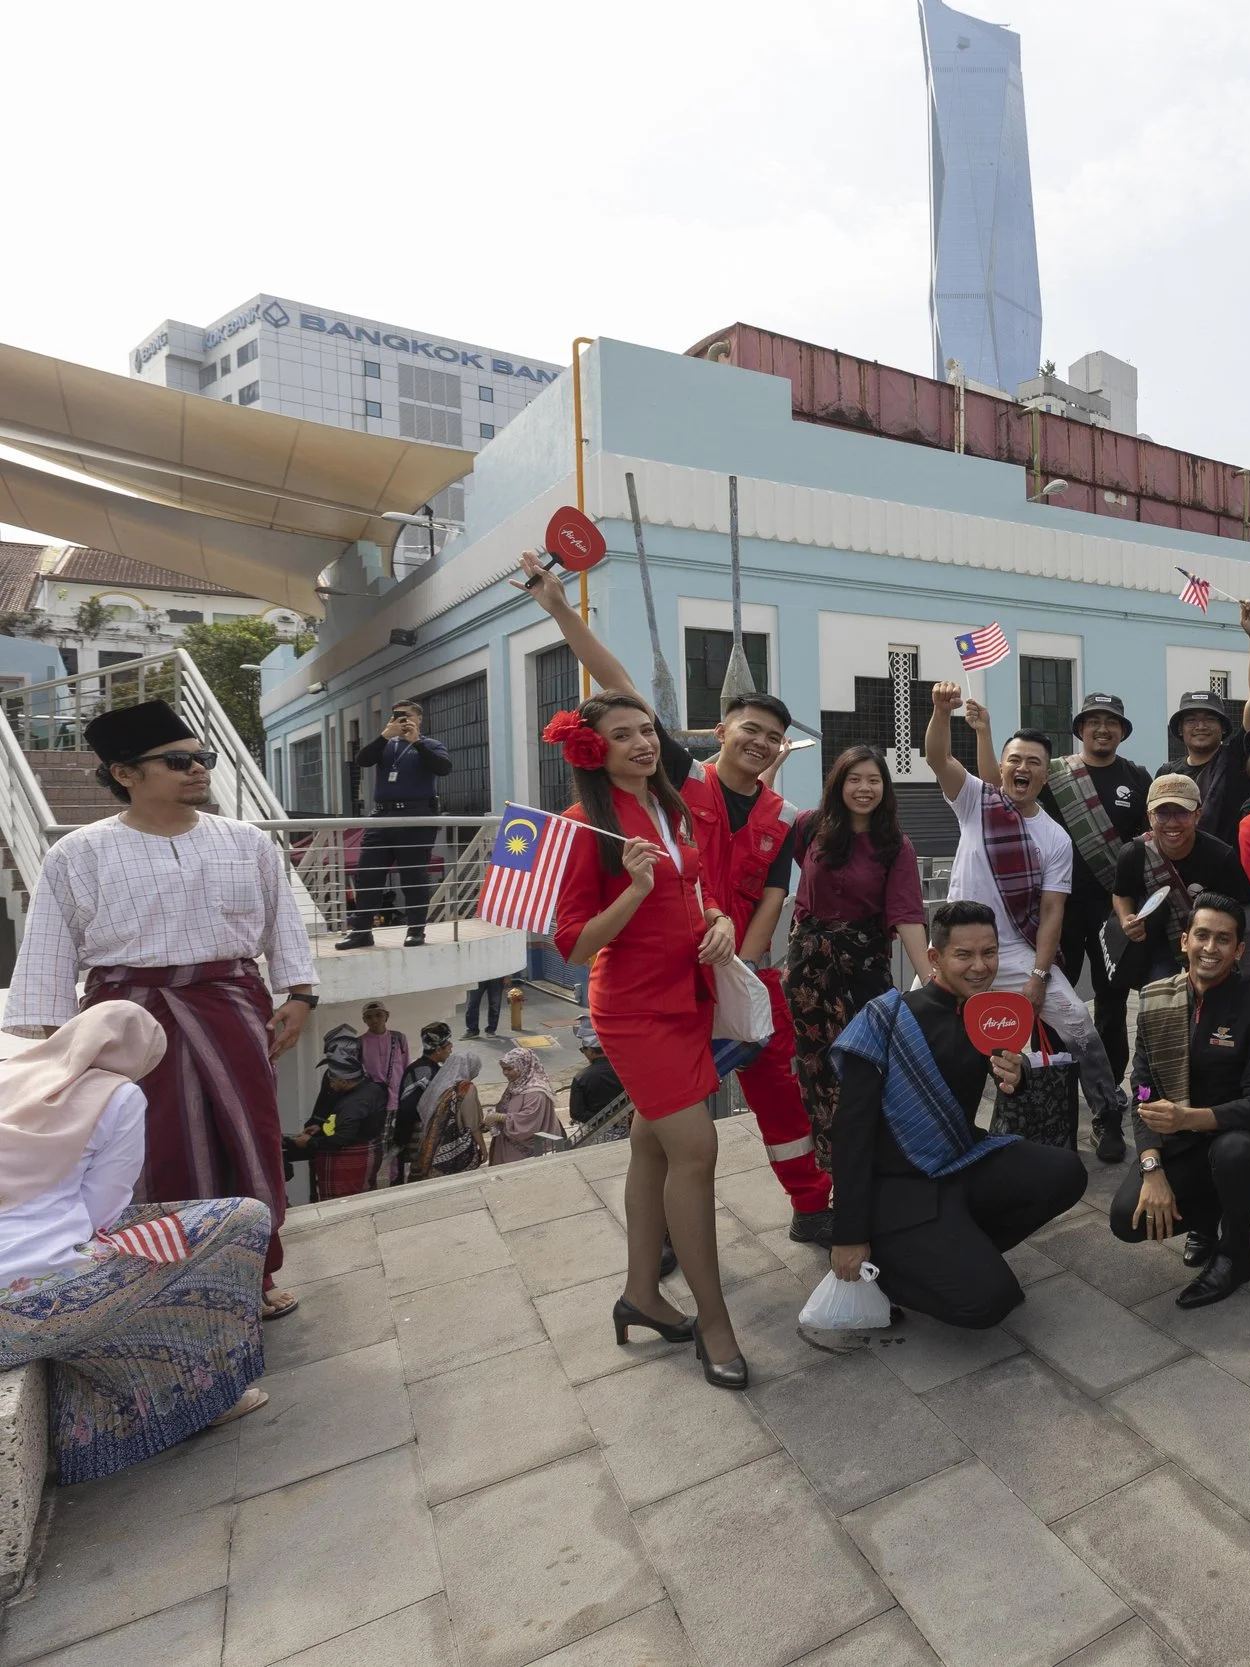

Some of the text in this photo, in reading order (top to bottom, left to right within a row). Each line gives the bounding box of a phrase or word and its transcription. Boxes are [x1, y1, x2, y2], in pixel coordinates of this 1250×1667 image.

[227, 304, 261, 338] BANK
[300, 313, 561, 383] BANGKOK BAN
[561, 529, 588, 553] AirAsia
[982, 1016, 1017, 1031] AirAsia
